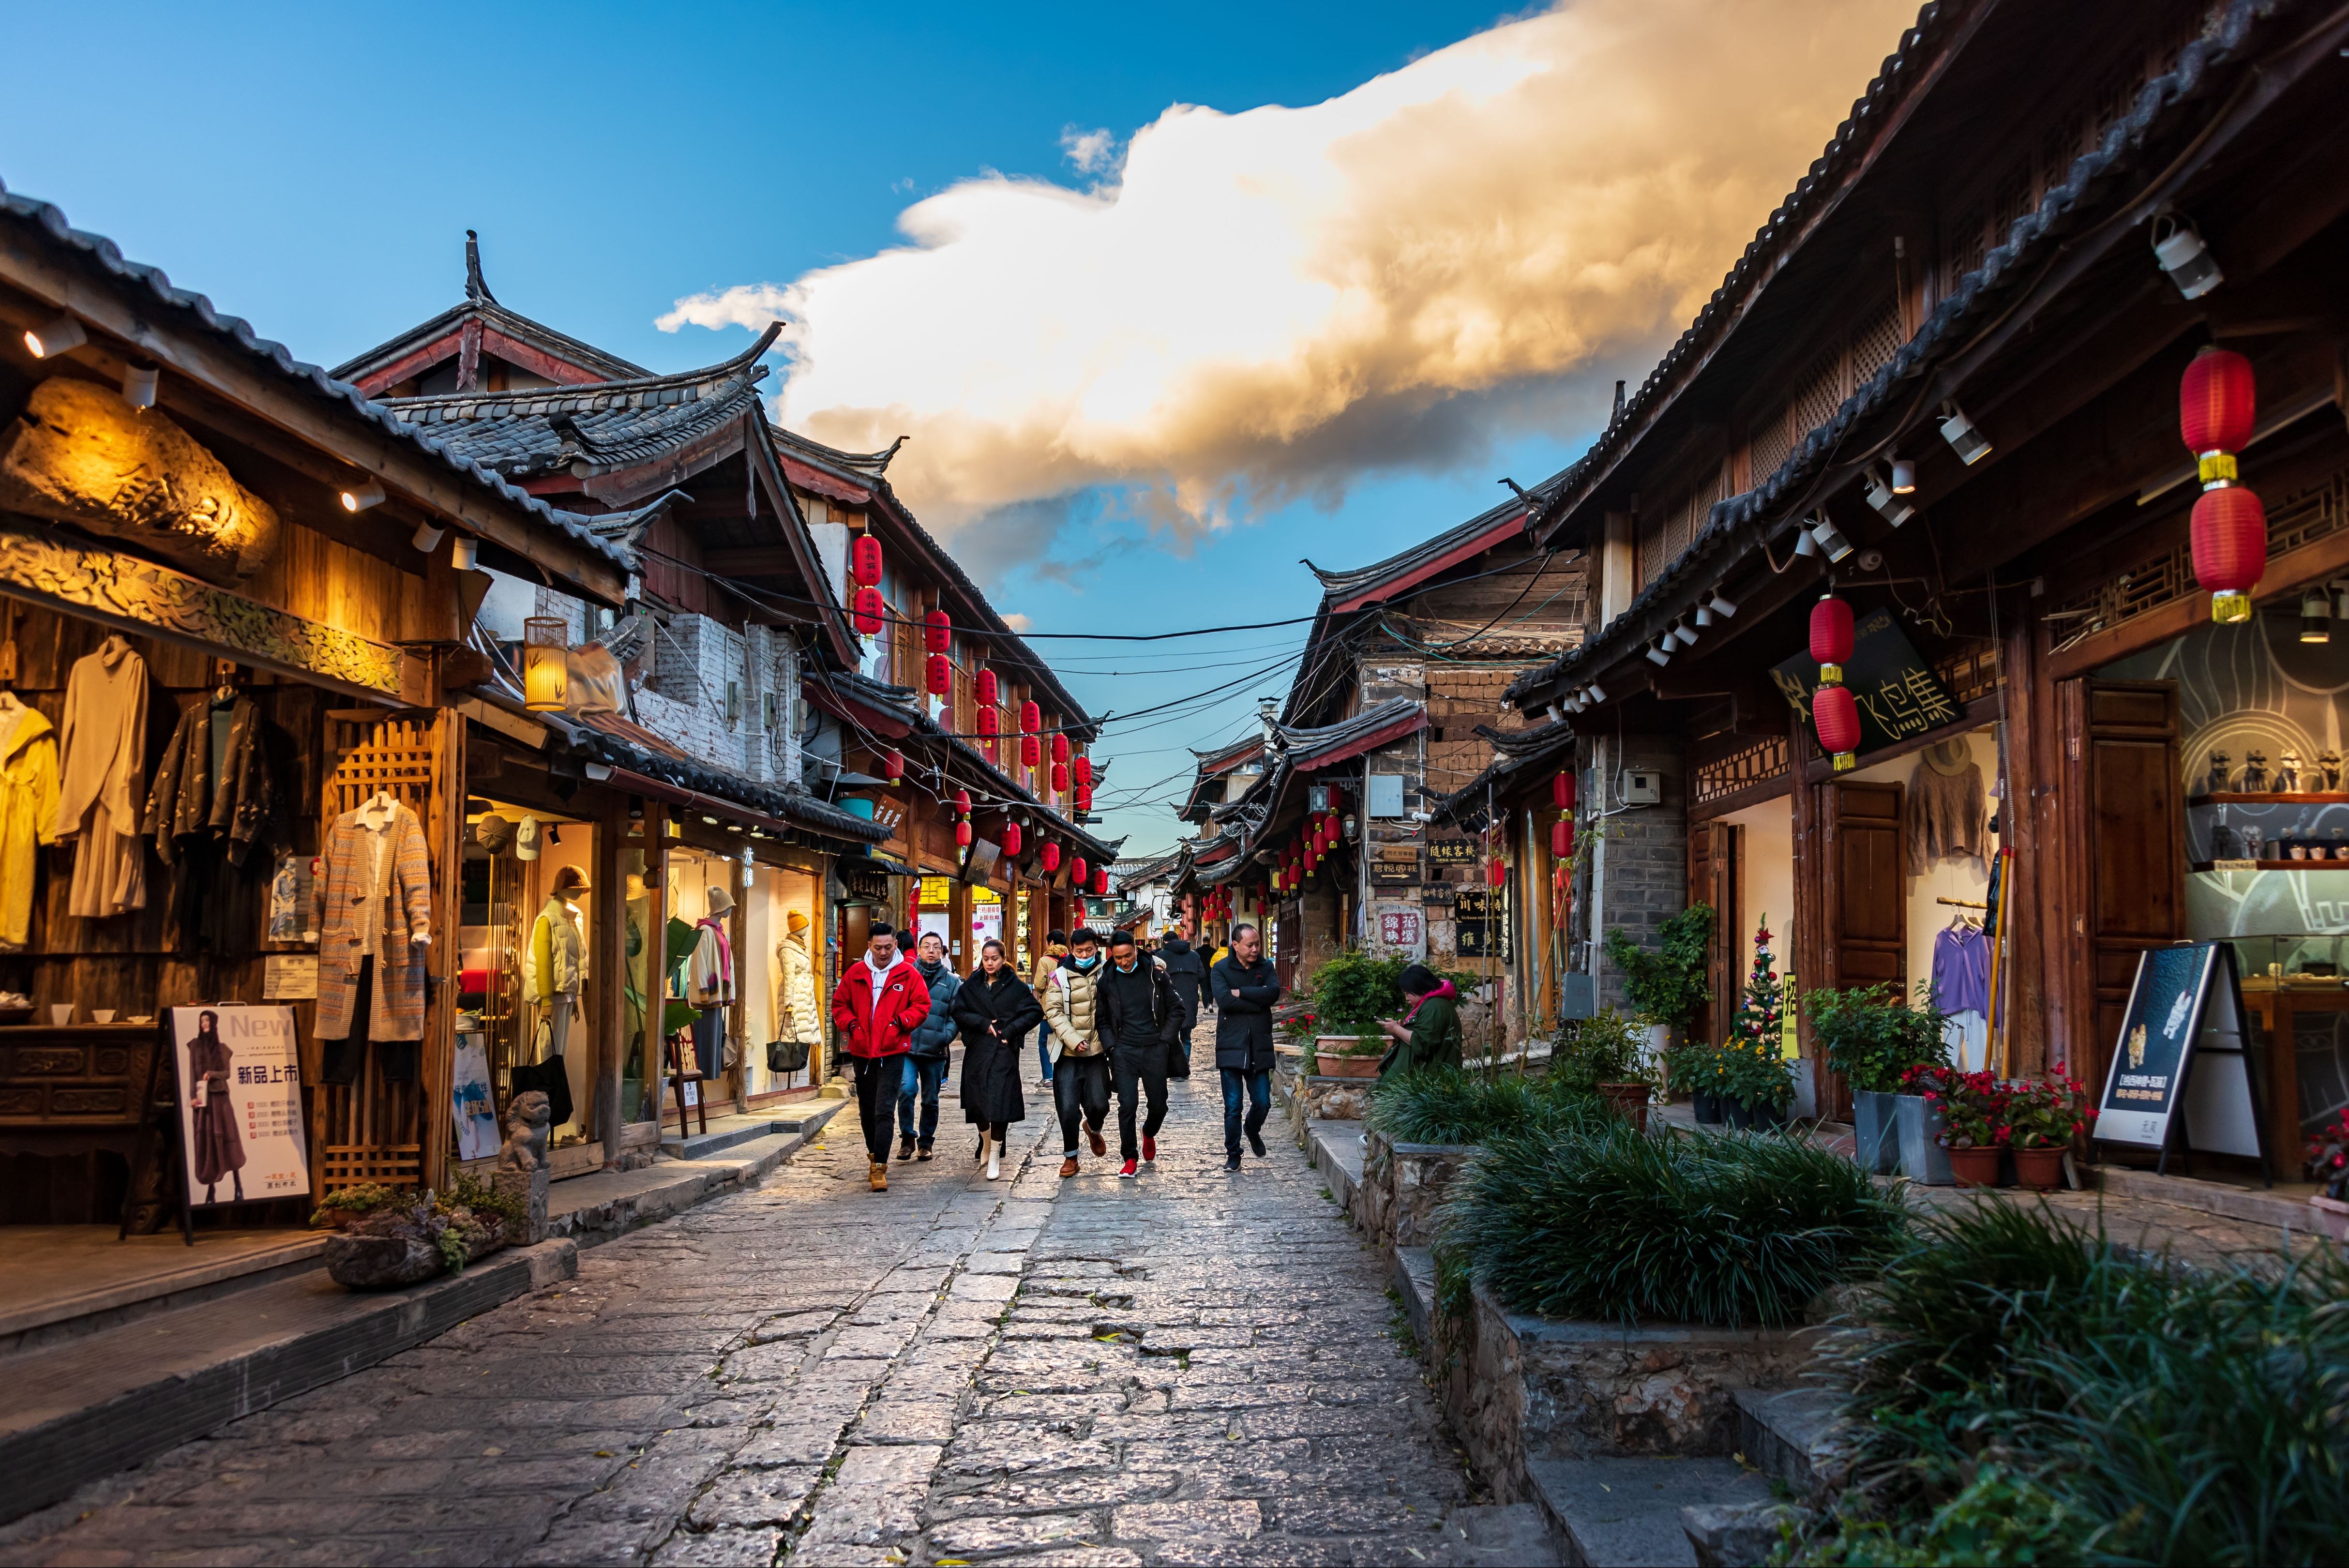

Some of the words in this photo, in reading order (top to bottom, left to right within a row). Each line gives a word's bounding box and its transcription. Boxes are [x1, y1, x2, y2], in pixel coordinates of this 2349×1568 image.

[1854, 667, 1956, 739] 飞鸟集
[1373, 864, 1417, 873] 君悦客栈
[230, 1015, 290, 1037] New
[238, 1064, 298, 1084] 新品上市
